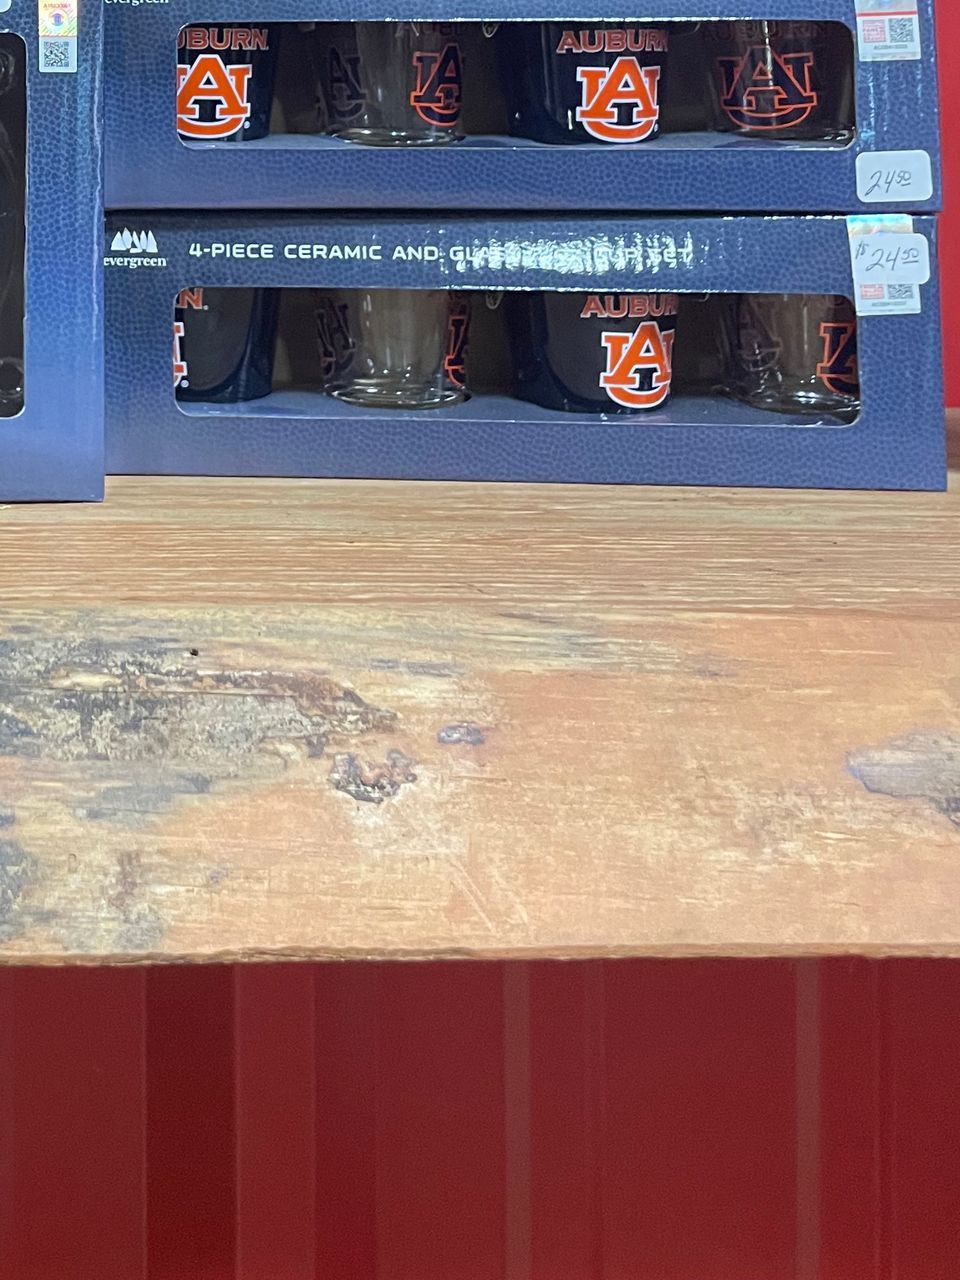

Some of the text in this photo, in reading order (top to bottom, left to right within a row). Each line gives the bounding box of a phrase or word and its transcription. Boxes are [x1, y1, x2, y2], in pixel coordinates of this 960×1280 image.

[189, 242, 274, 258] 4-PIECE
[284, 244, 382, 260] CERAMIC
[392, 245, 440, 260] AND
[103, 256, 167, 269] evergreen
